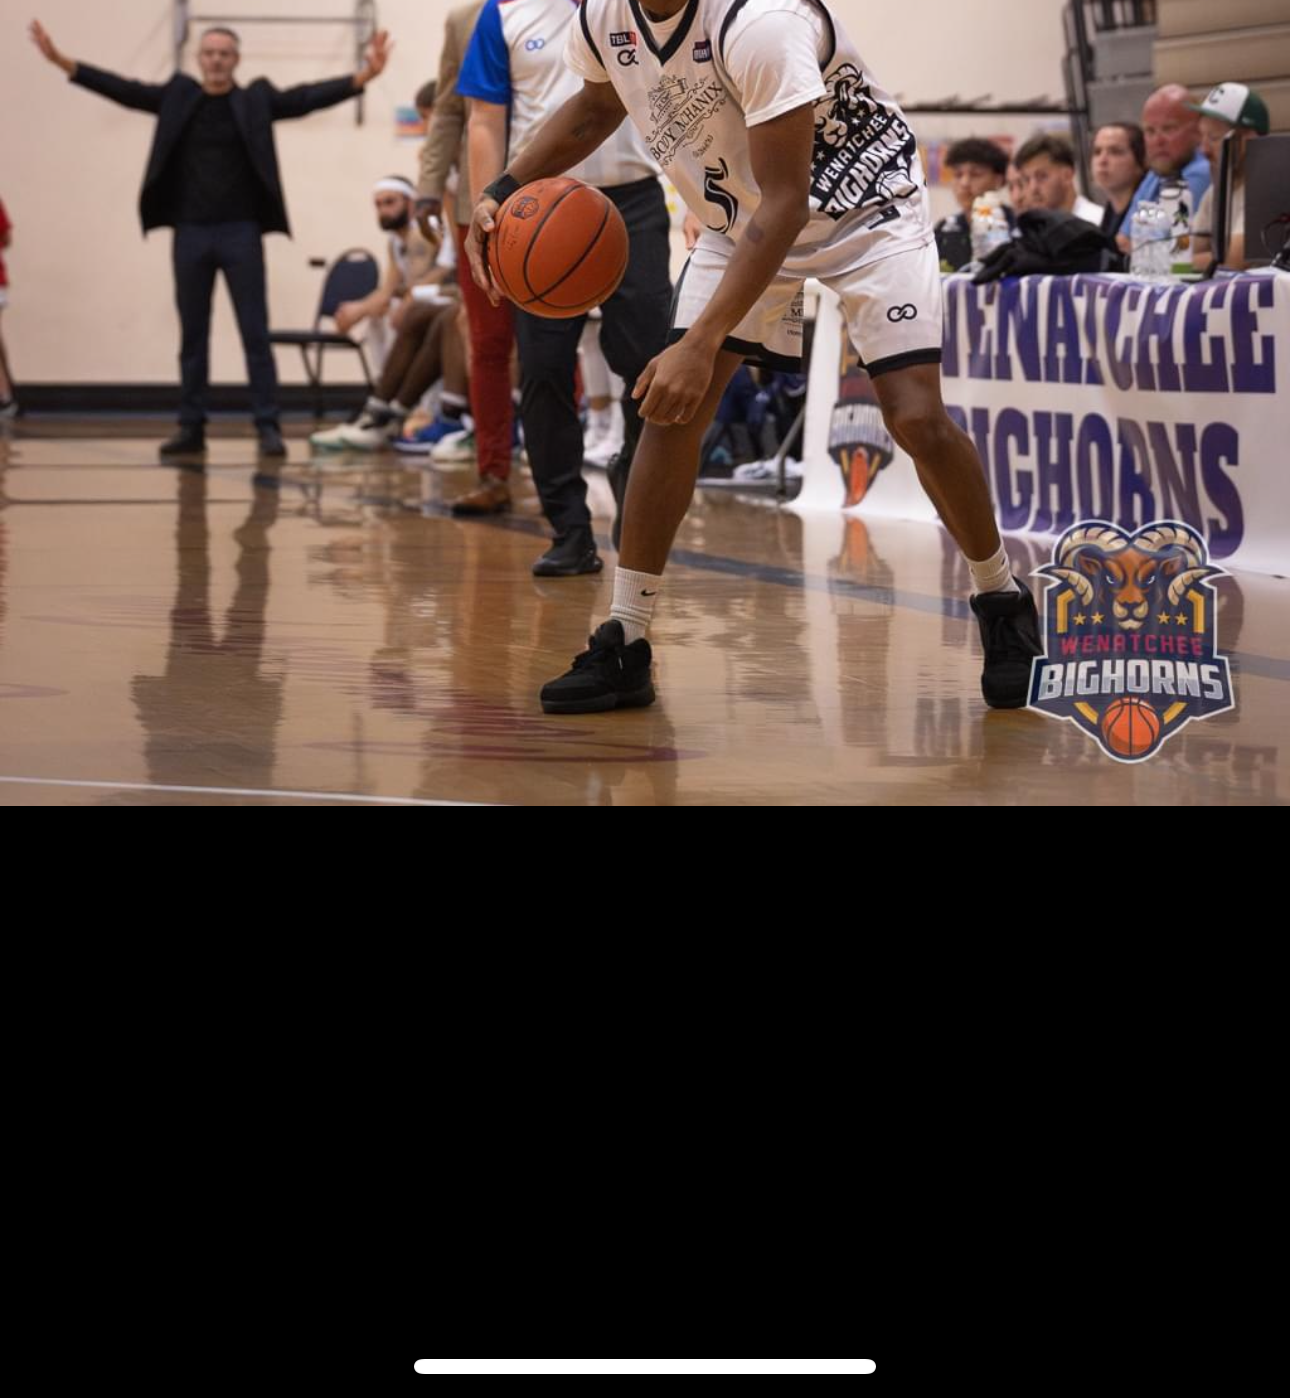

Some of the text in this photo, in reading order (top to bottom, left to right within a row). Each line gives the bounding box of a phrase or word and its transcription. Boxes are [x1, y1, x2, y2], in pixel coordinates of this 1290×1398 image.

[611, 33, 631, 45] TBL
[650, 127, 676, 160] BODY
[815, 113, 888, 193] WENATCHEE
[703, 156, 739, 235] 5
[946, 404, 1244, 560] IGHORNS
